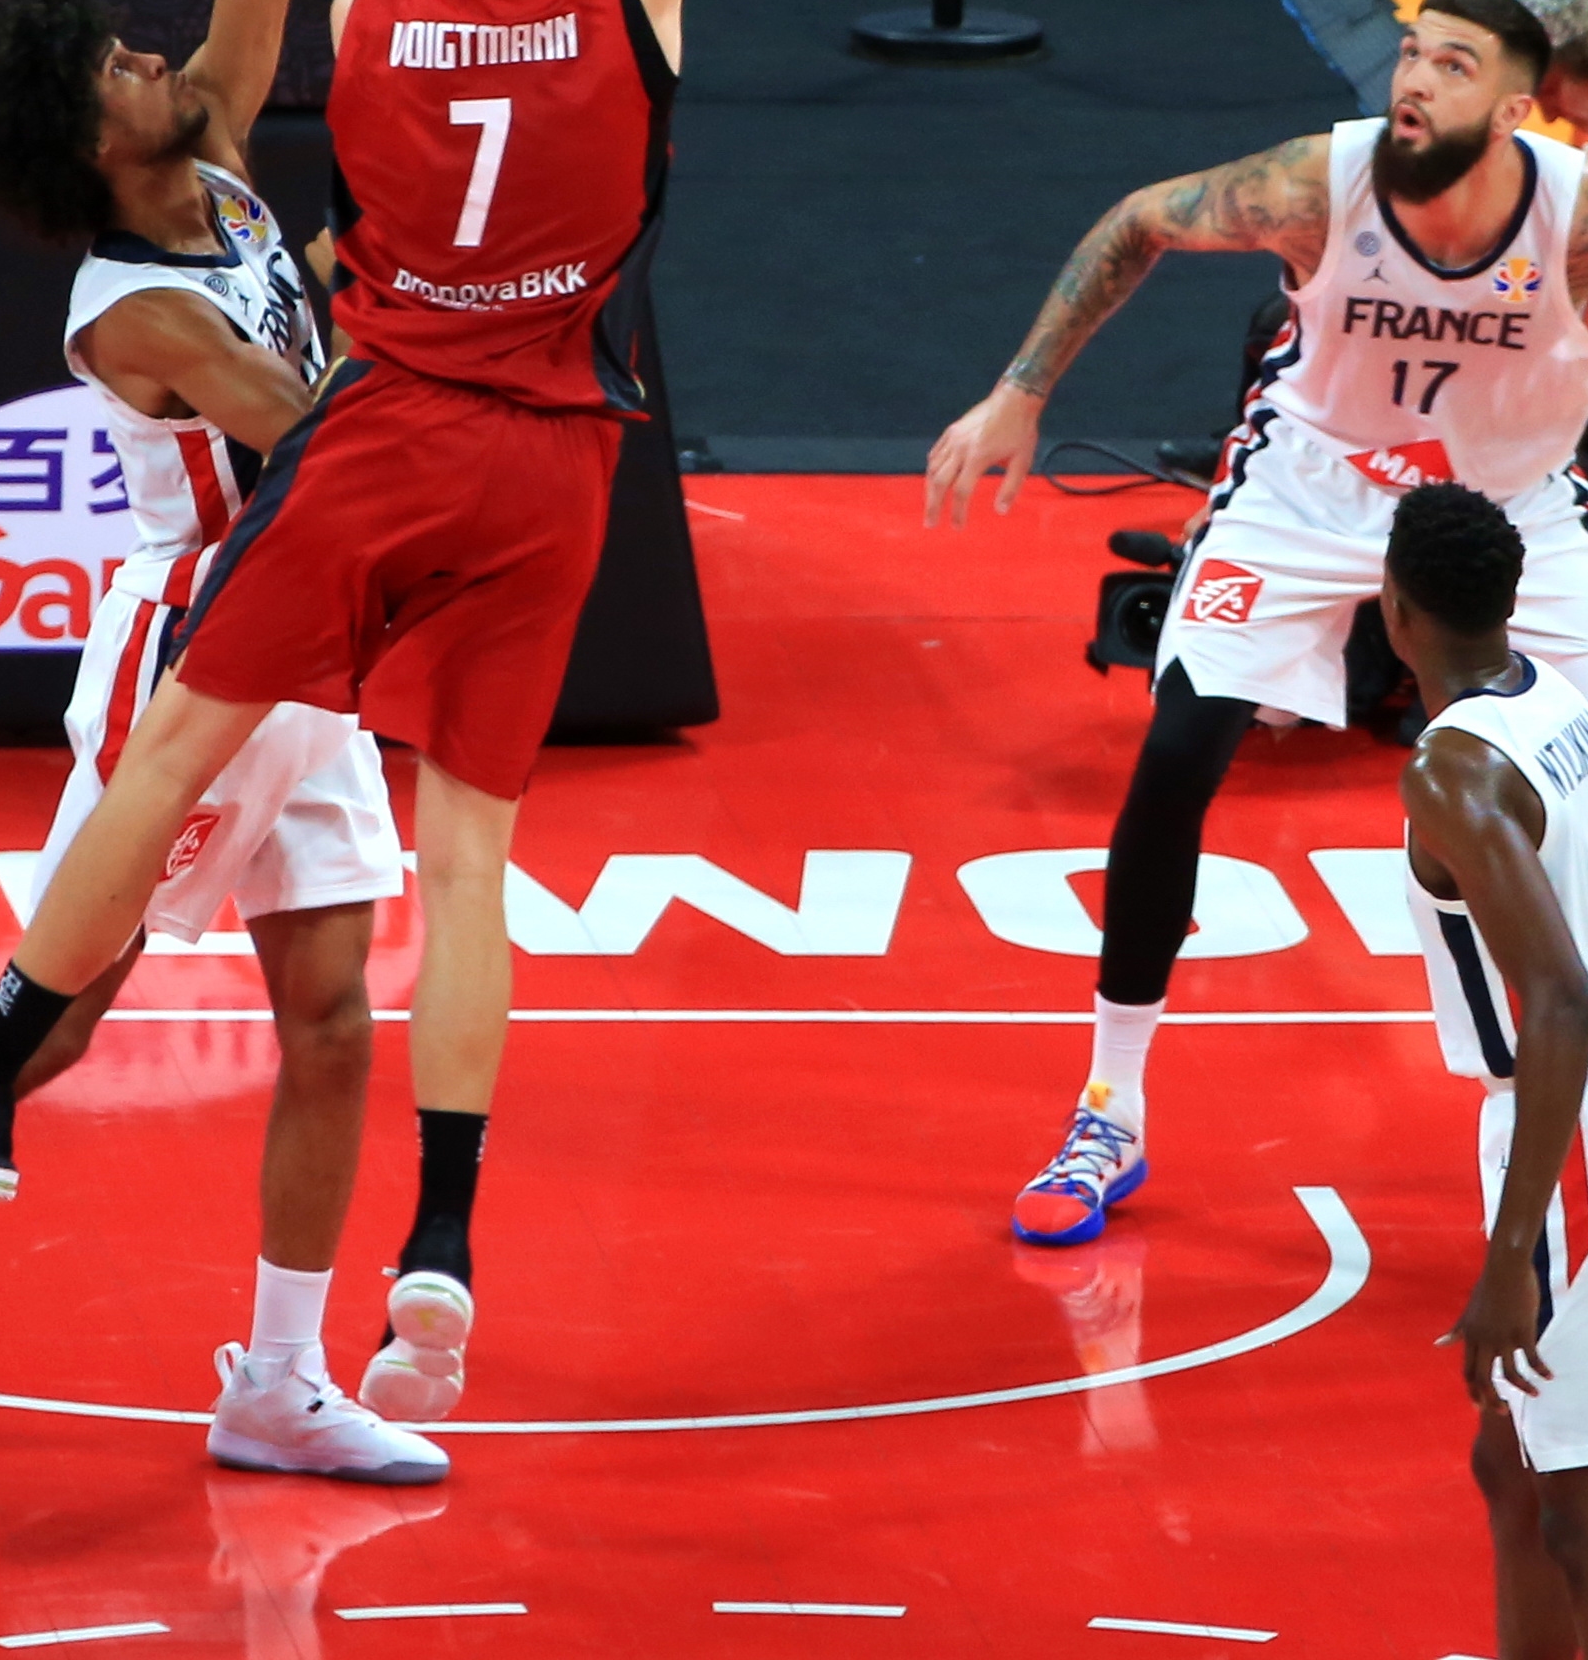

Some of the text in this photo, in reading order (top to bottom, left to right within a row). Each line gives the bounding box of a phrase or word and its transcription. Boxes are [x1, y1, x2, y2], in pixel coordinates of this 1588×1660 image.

[388, 12, 579, 70] VOIGTMANN
[448, 96, 513, 248] 7
[1342, 297, 1531, 352] FRANCE
[1390, 358, 1461, 416] 17
[1366, 449, 1445, 489] MA
